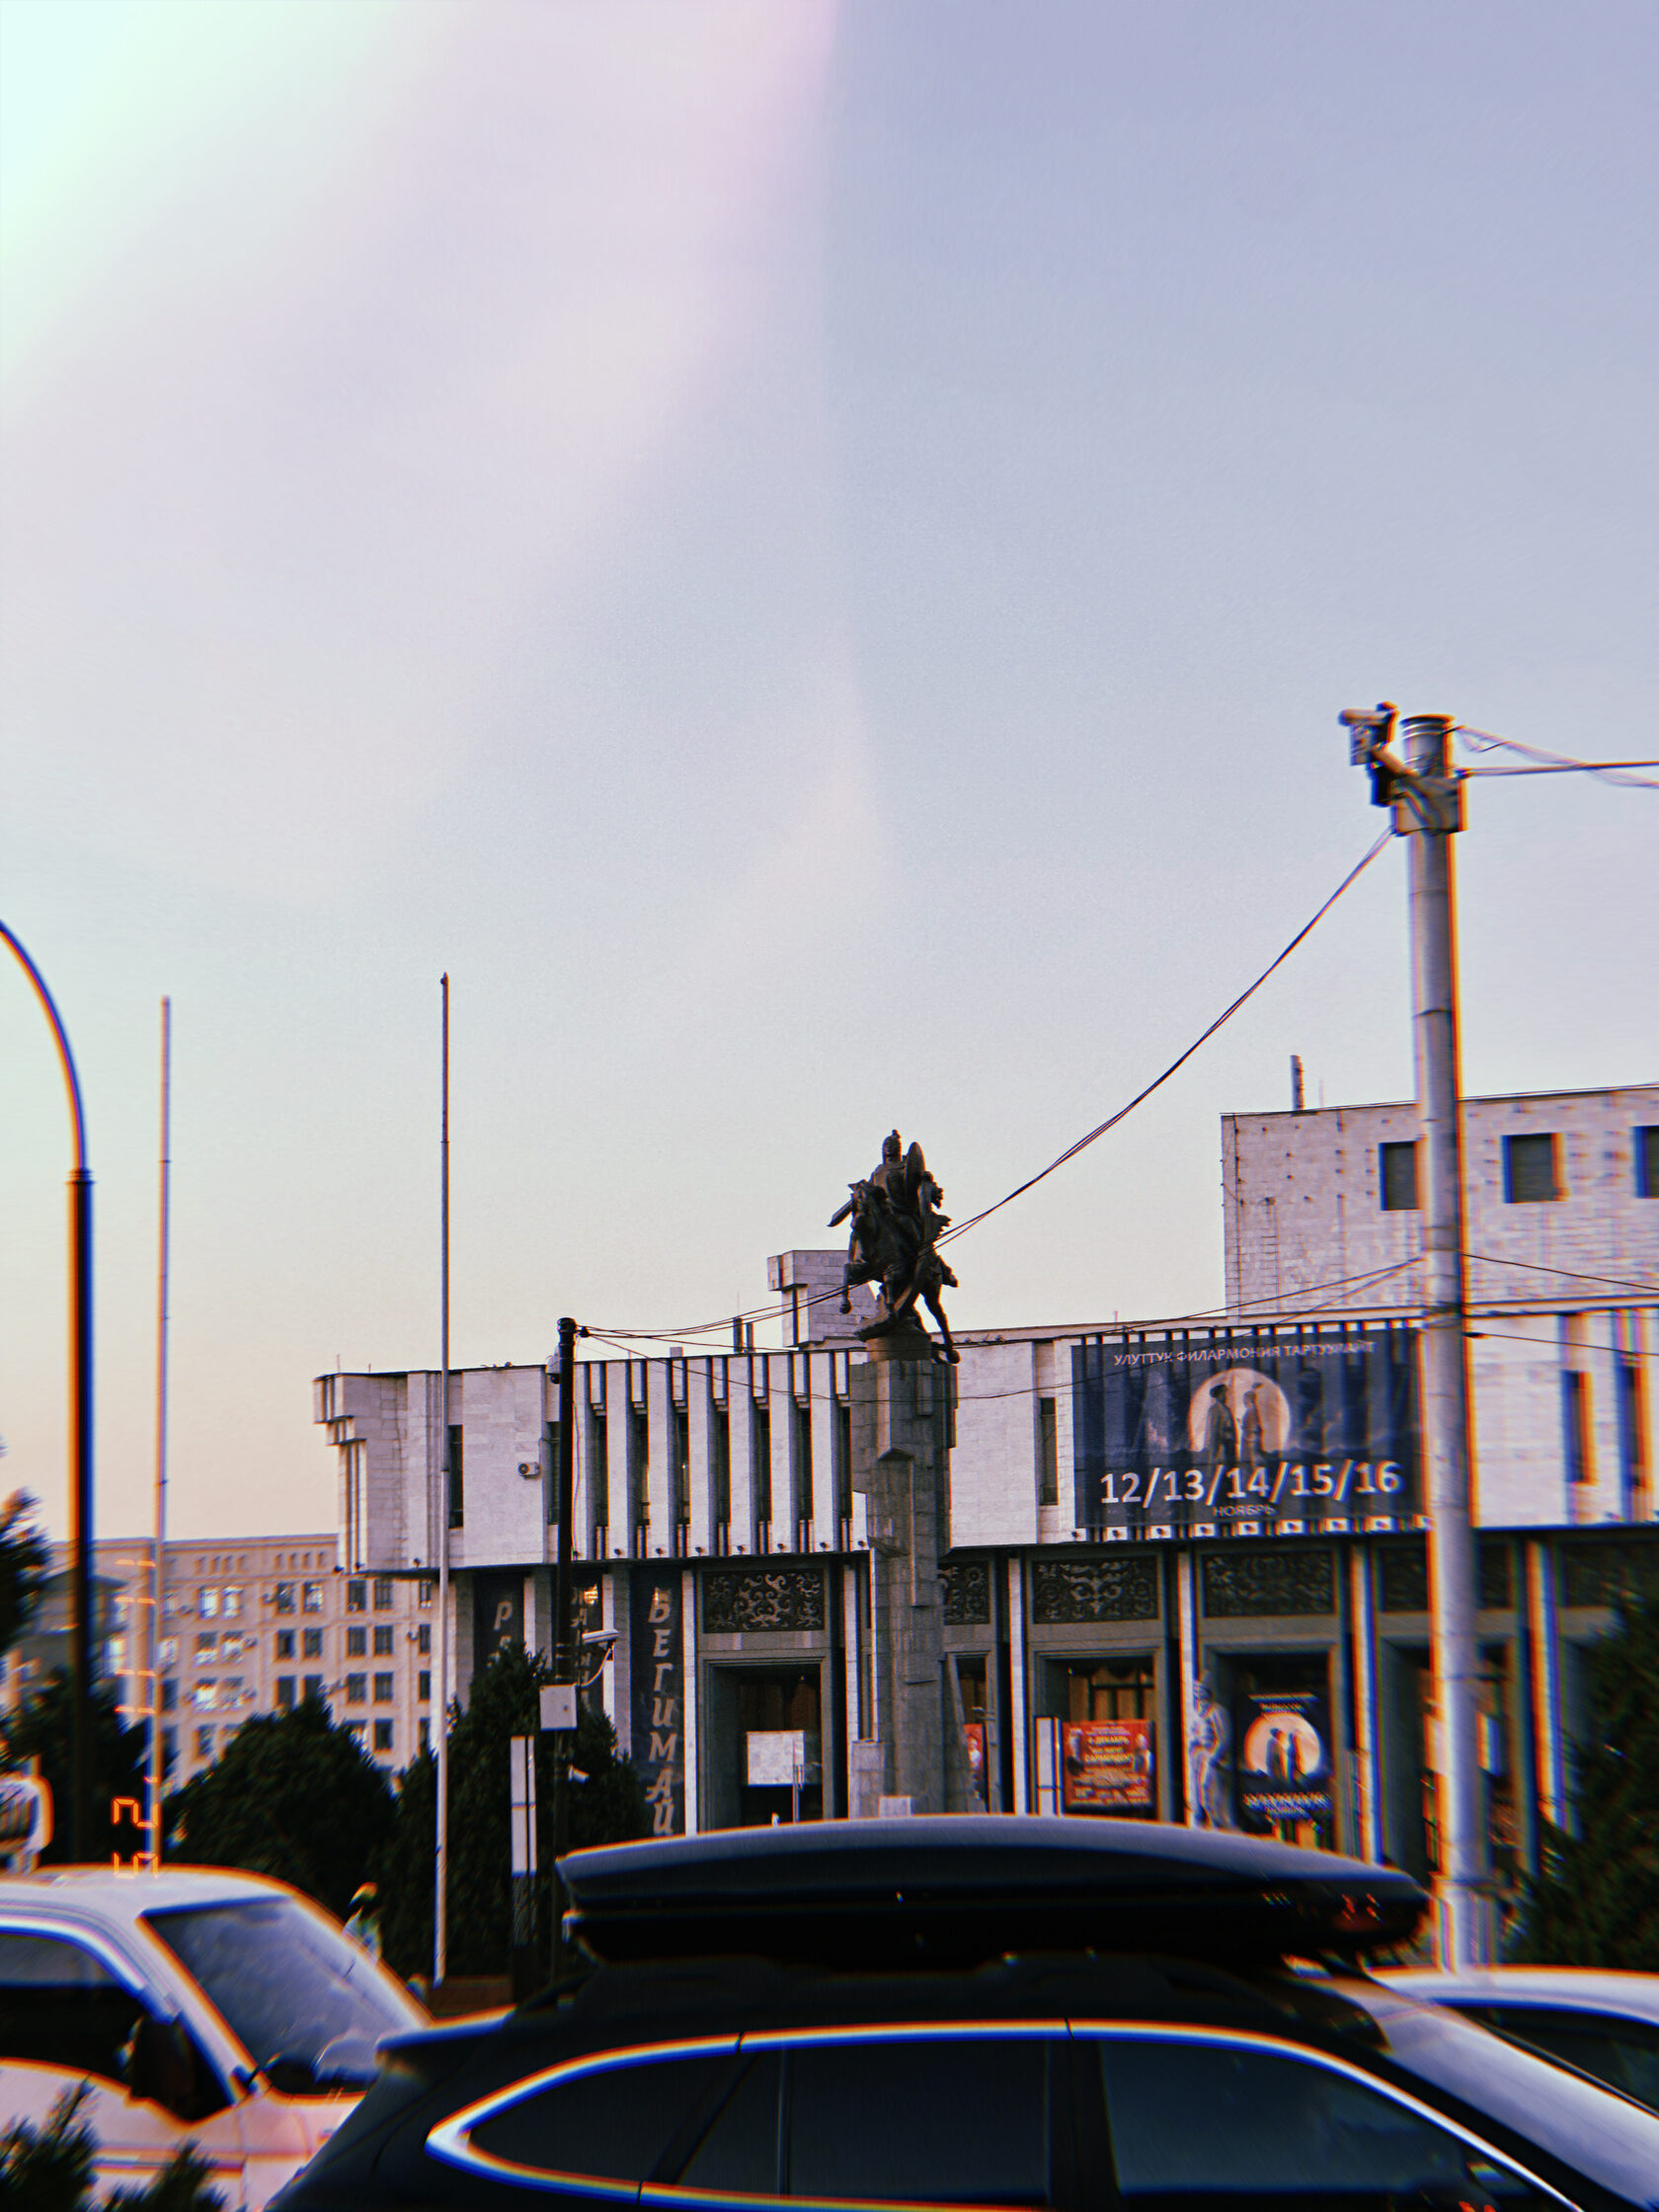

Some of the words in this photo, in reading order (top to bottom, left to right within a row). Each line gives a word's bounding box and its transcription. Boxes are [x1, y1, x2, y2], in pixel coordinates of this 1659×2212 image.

[1114, 1352, 1173, 1367] УЛУТТУК
[1176, 1345, 1281, 1363] ФИЛАРМОНИЯ
[1100, 1459, 1404, 1509] 12/13/14/15/16
[1213, 1504, 1278, 1518] НОЯБРЬ
